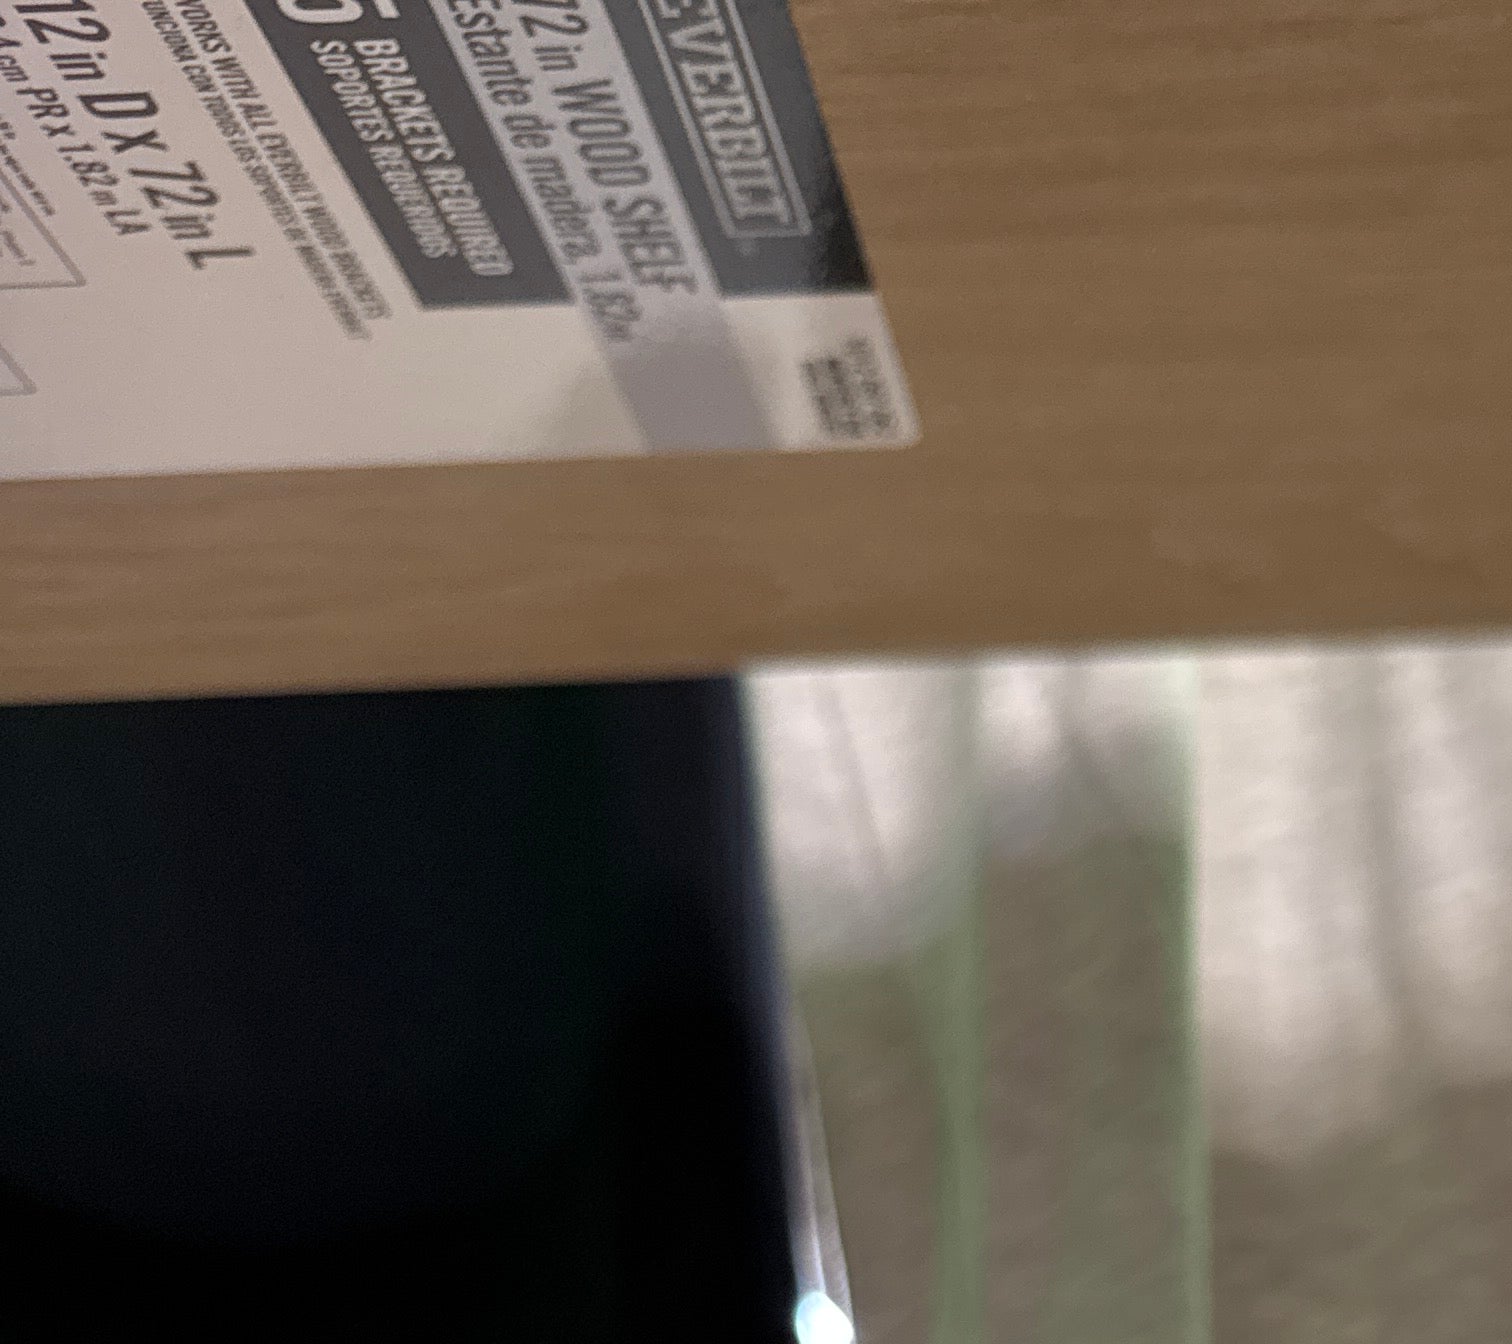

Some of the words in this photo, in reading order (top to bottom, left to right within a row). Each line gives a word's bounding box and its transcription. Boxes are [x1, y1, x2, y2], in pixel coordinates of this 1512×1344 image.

[13, 0, 111, 43] 12
[48, 51, 107, 81] in
[211, 56, 261, 100] WITH
[533, 46, 583, 71] in
[181, 64, 219, 93] CON
[309, 39, 395, 142] SOPORTES
[76, 91, 159, 119] D
[235, 103, 278, 132] ALL
[503, 114, 557, 149] de
[552, 78, 650, 187] WOOD
[15, 87, 70, 119] PR
[57, 143, 120, 188] 1.82
[103, 209, 153, 236] LA
[353, 38, 455, 162] BRACKETS
[422, 165, 514, 276] REQUIRED
[127, 161, 221, 209] 72
[159, 213, 216, 241] in
[604, 195, 696, 294] SHELF
[184, 245, 256, 270] L
